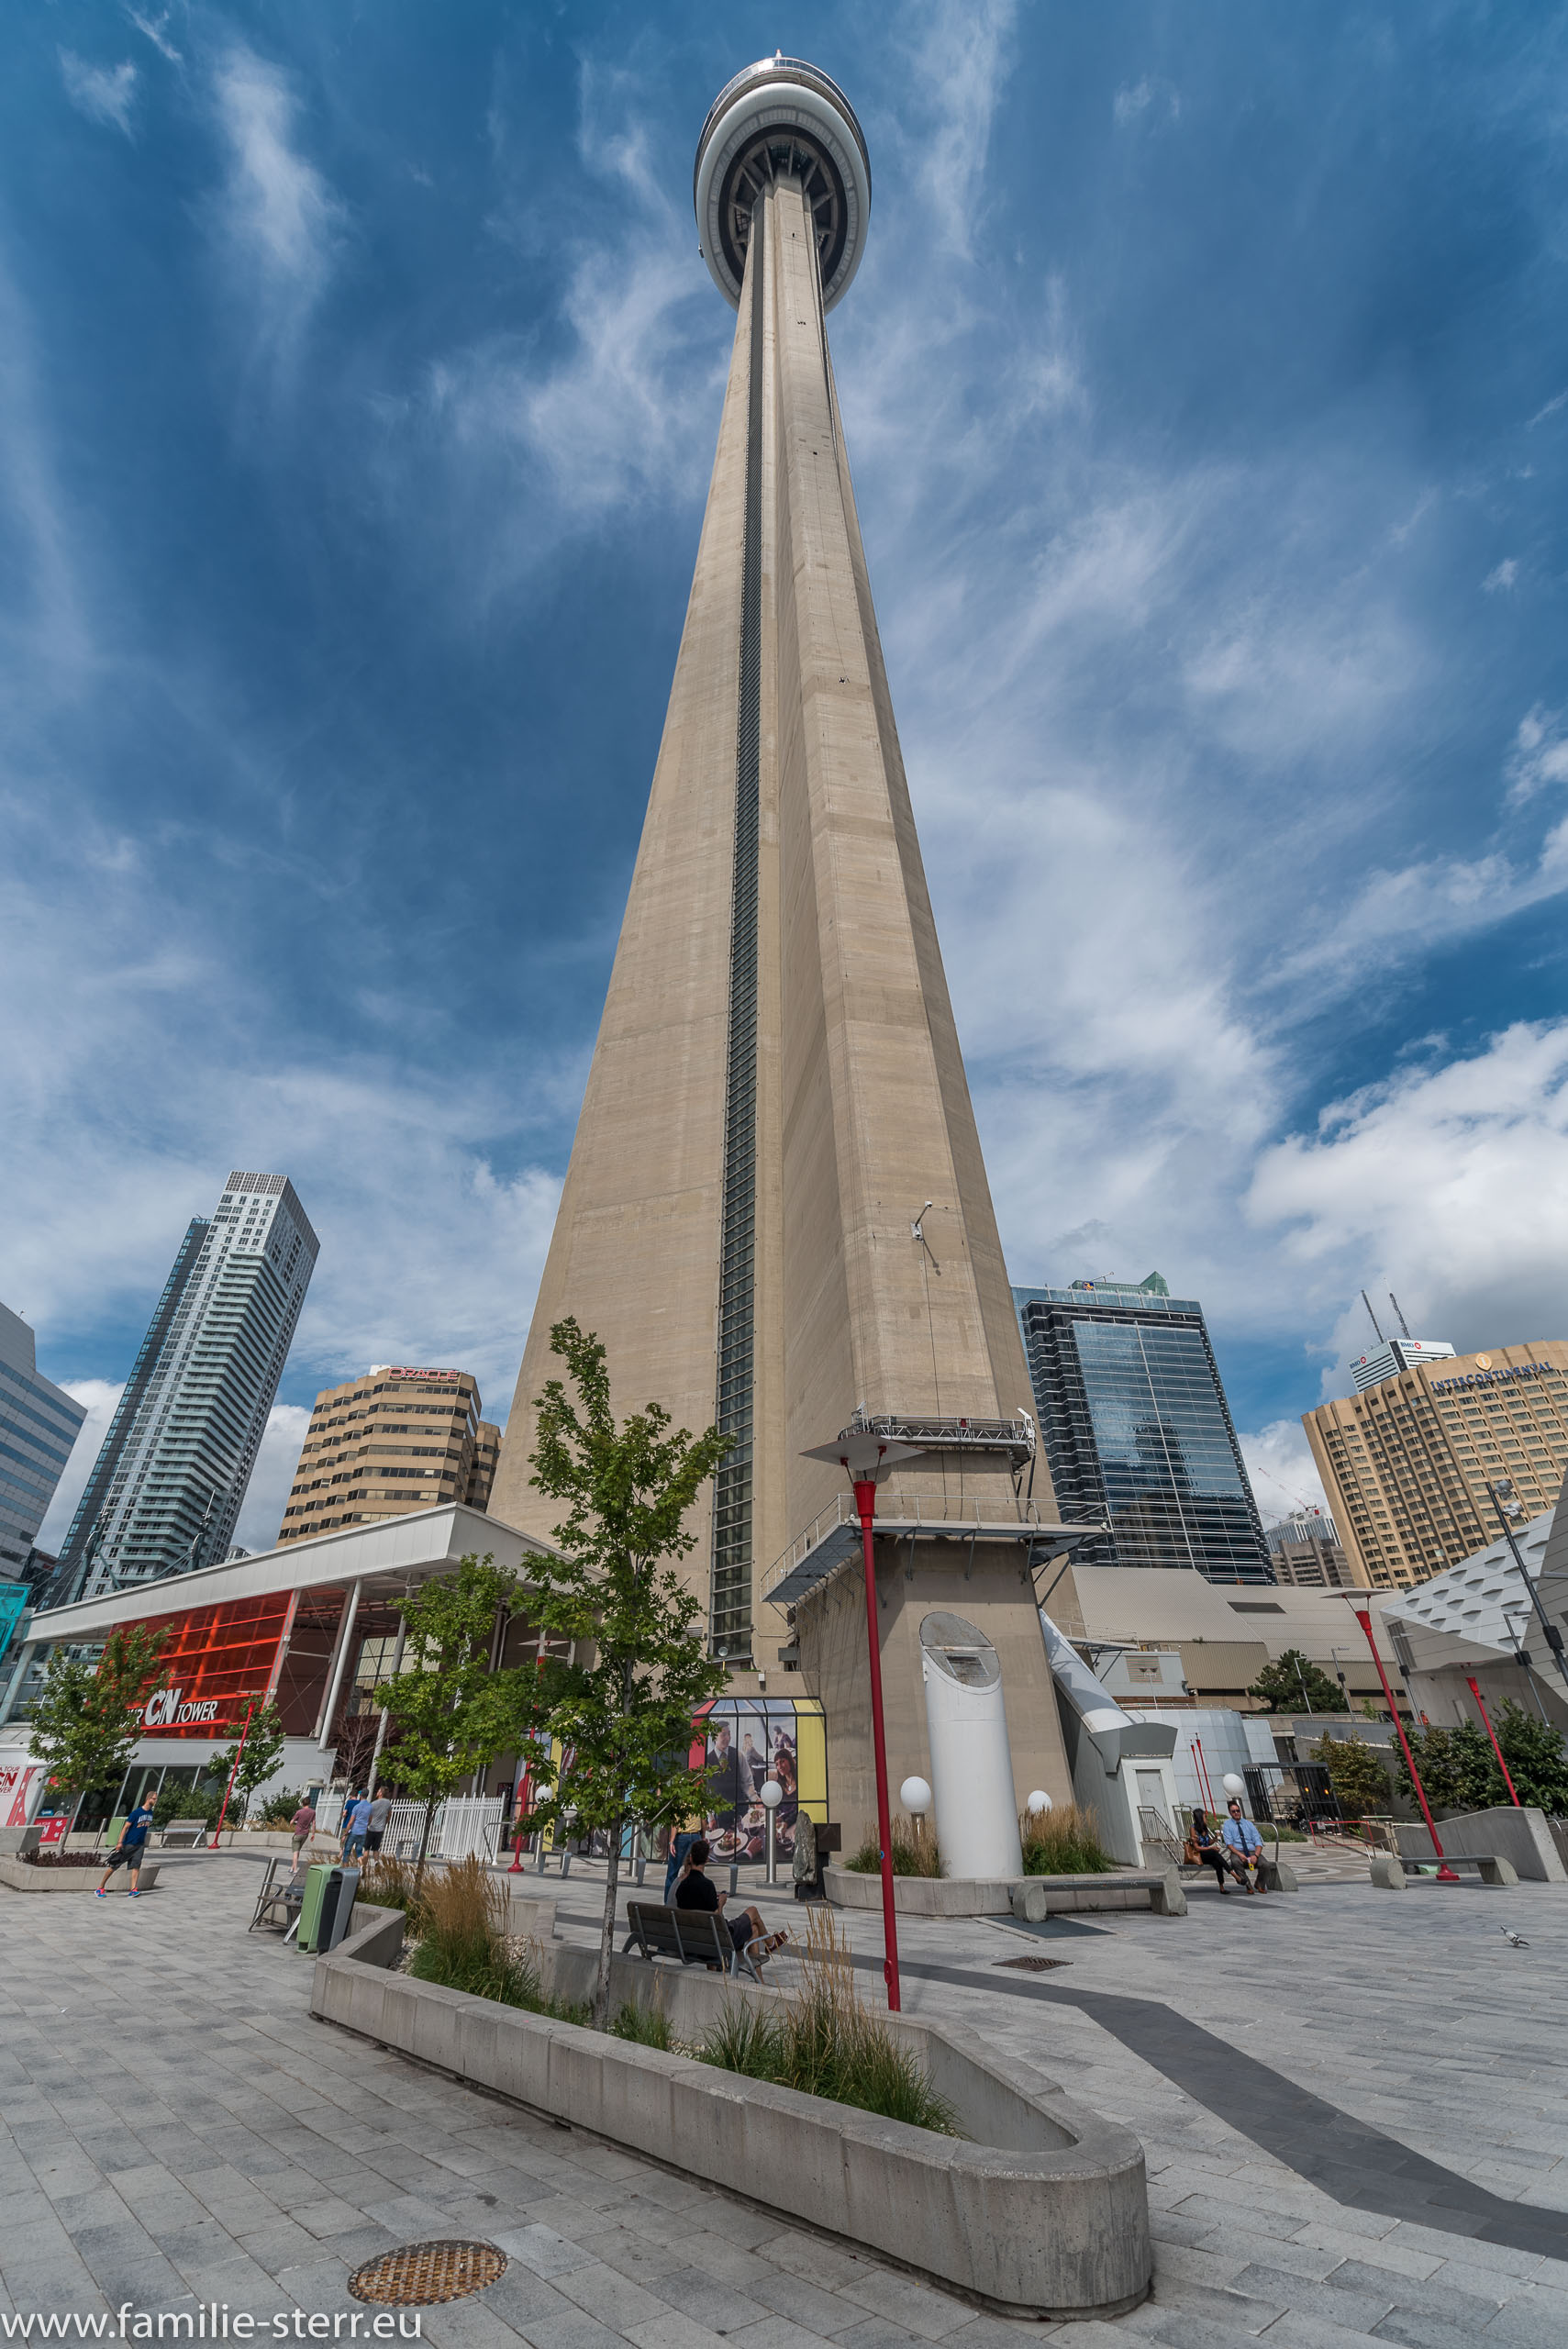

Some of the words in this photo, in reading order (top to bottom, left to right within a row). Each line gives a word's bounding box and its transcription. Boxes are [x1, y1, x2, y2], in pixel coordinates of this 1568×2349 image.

[1349, 1360, 1361, 1369] BMO
[389, 1367, 459, 1380] ORACLE
[145, 1688, 183, 1726] CN
[176, 1700, 218, 1723] TOWER
